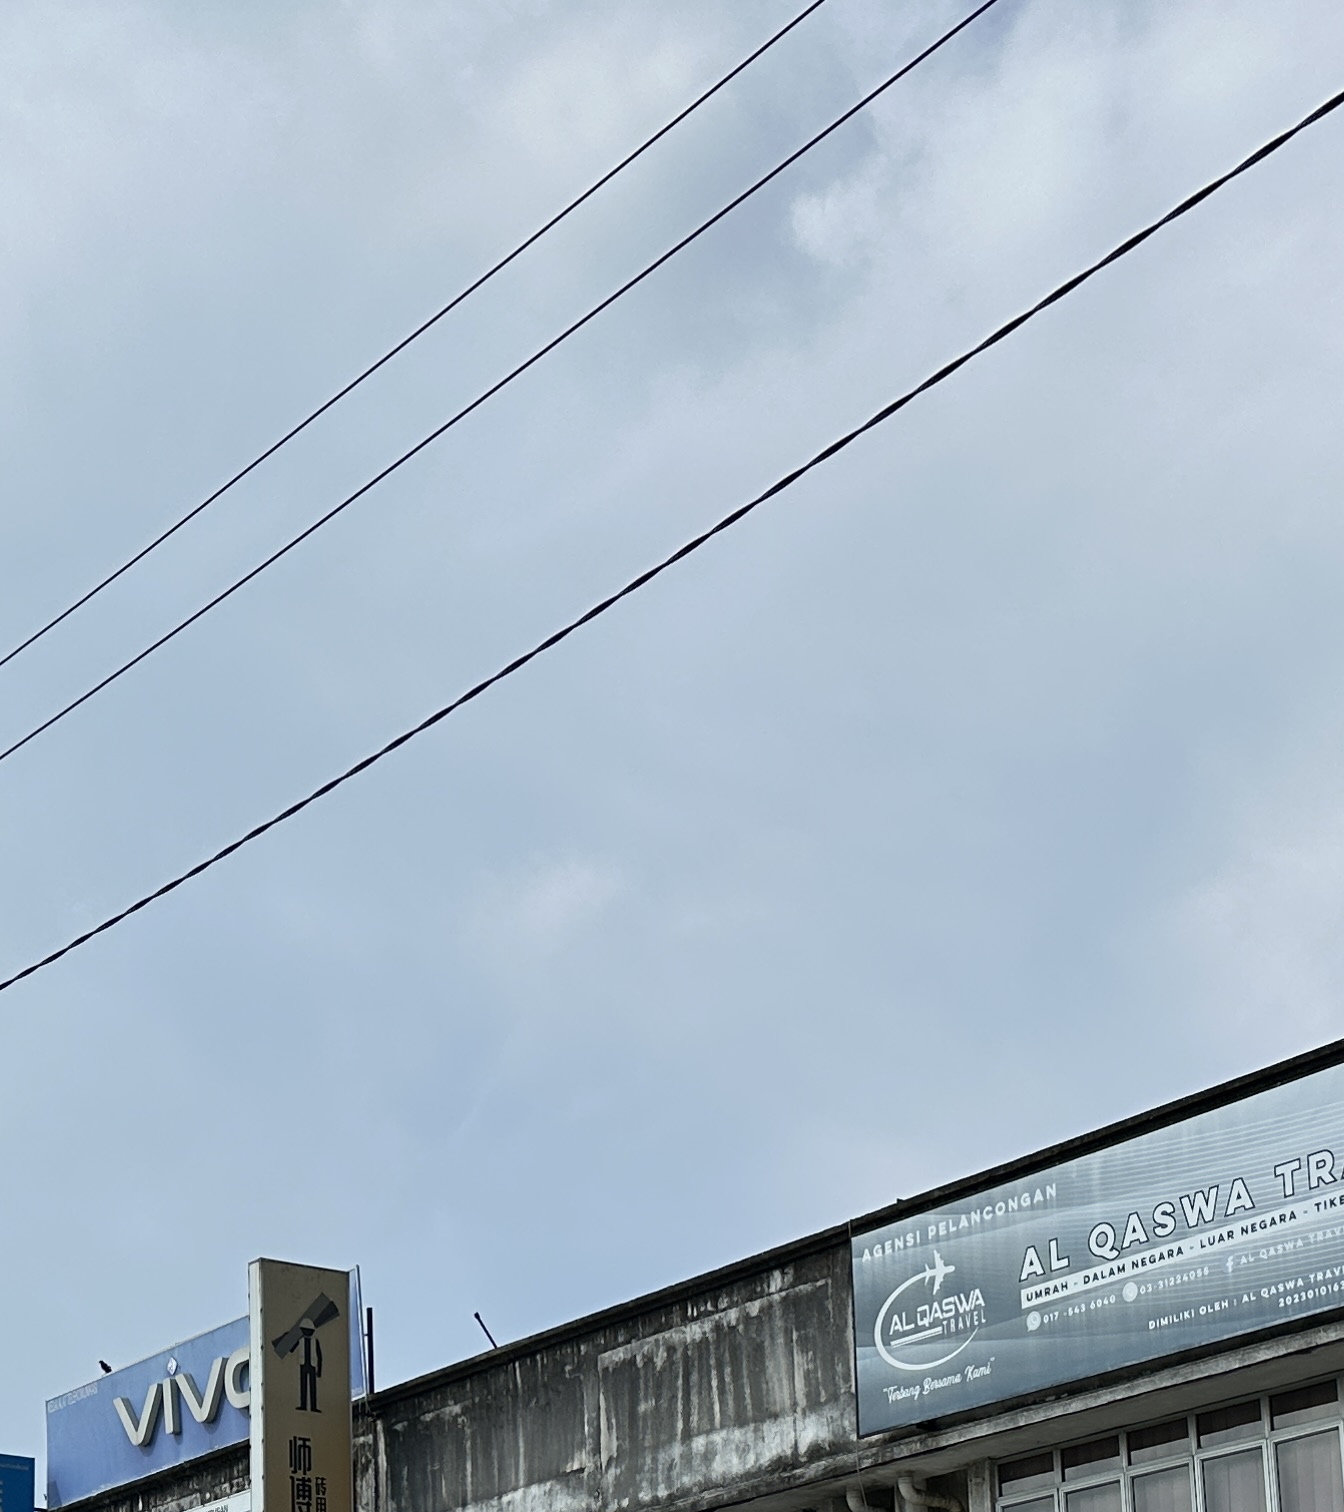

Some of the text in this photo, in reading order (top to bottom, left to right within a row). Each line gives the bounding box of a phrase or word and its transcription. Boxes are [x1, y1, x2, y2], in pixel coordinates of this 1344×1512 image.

[861, 1183, 1057, 1263] AGENSI PELANCONGAN
[1019, 1238, 1071, 1282] AL
[1088, 1177, 1255, 1260] QASWA
[1026, 1281, 1069, 1302] UMRAH
[1083, 1264, 1126, 1285] DALAM
[1132, 1245, 1184, 1270] NEGARA
[1199, 1230, 1235, 1249] LUAR
[1241, 1211, 1297, 1237] NEGARA
[1240, 1254, 1255, 1267] AL
[1259, 1238, 1304, 1262] QASWA
[889, 1288, 985, 1336] AL QASWA
[942, 1312, 987, 1336] TRAVEL
[1148, 1310, 1196, 1331] DIMILIKI
[1199, 1299, 1229, 1316] OLEH
[1241, 1292, 1256, 1304] AL
[1260, 1279, 1304, 1300] QASWA
[922, 1373, 962, 1395] Bersama
